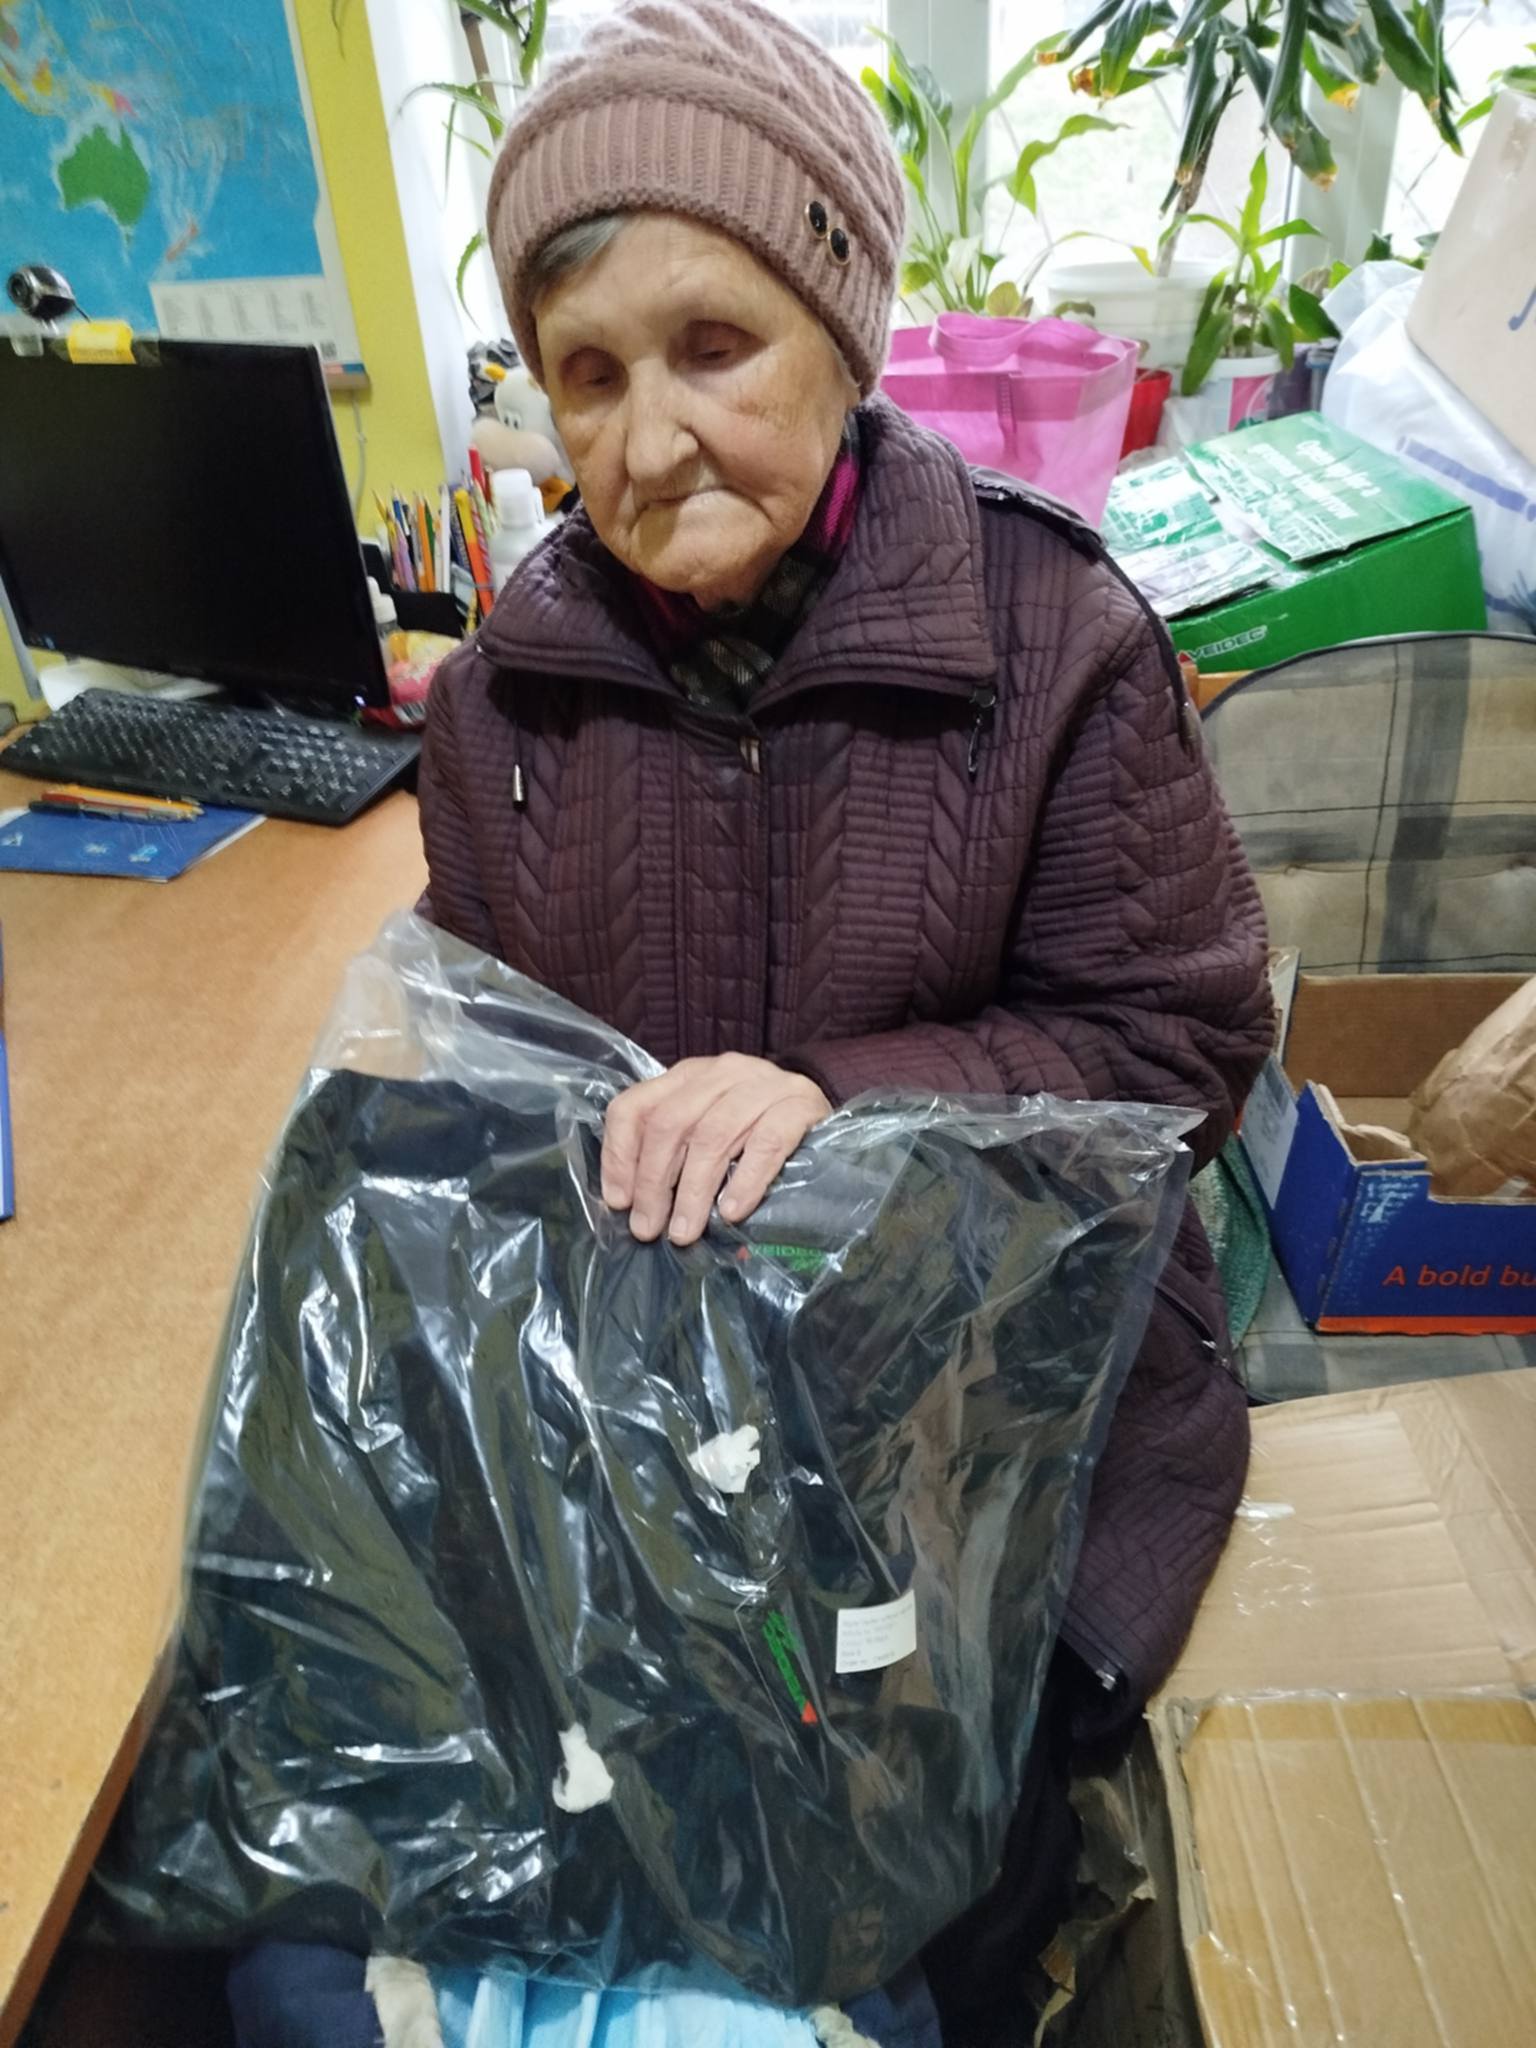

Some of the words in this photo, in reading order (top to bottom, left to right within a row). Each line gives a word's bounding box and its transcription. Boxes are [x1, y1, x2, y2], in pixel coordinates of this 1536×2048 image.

[1189, 625, 1268, 658] VEIDEC
[1381, 1264, 1406, 1287] A
[1417, 1264, 1492, 1288] bold
